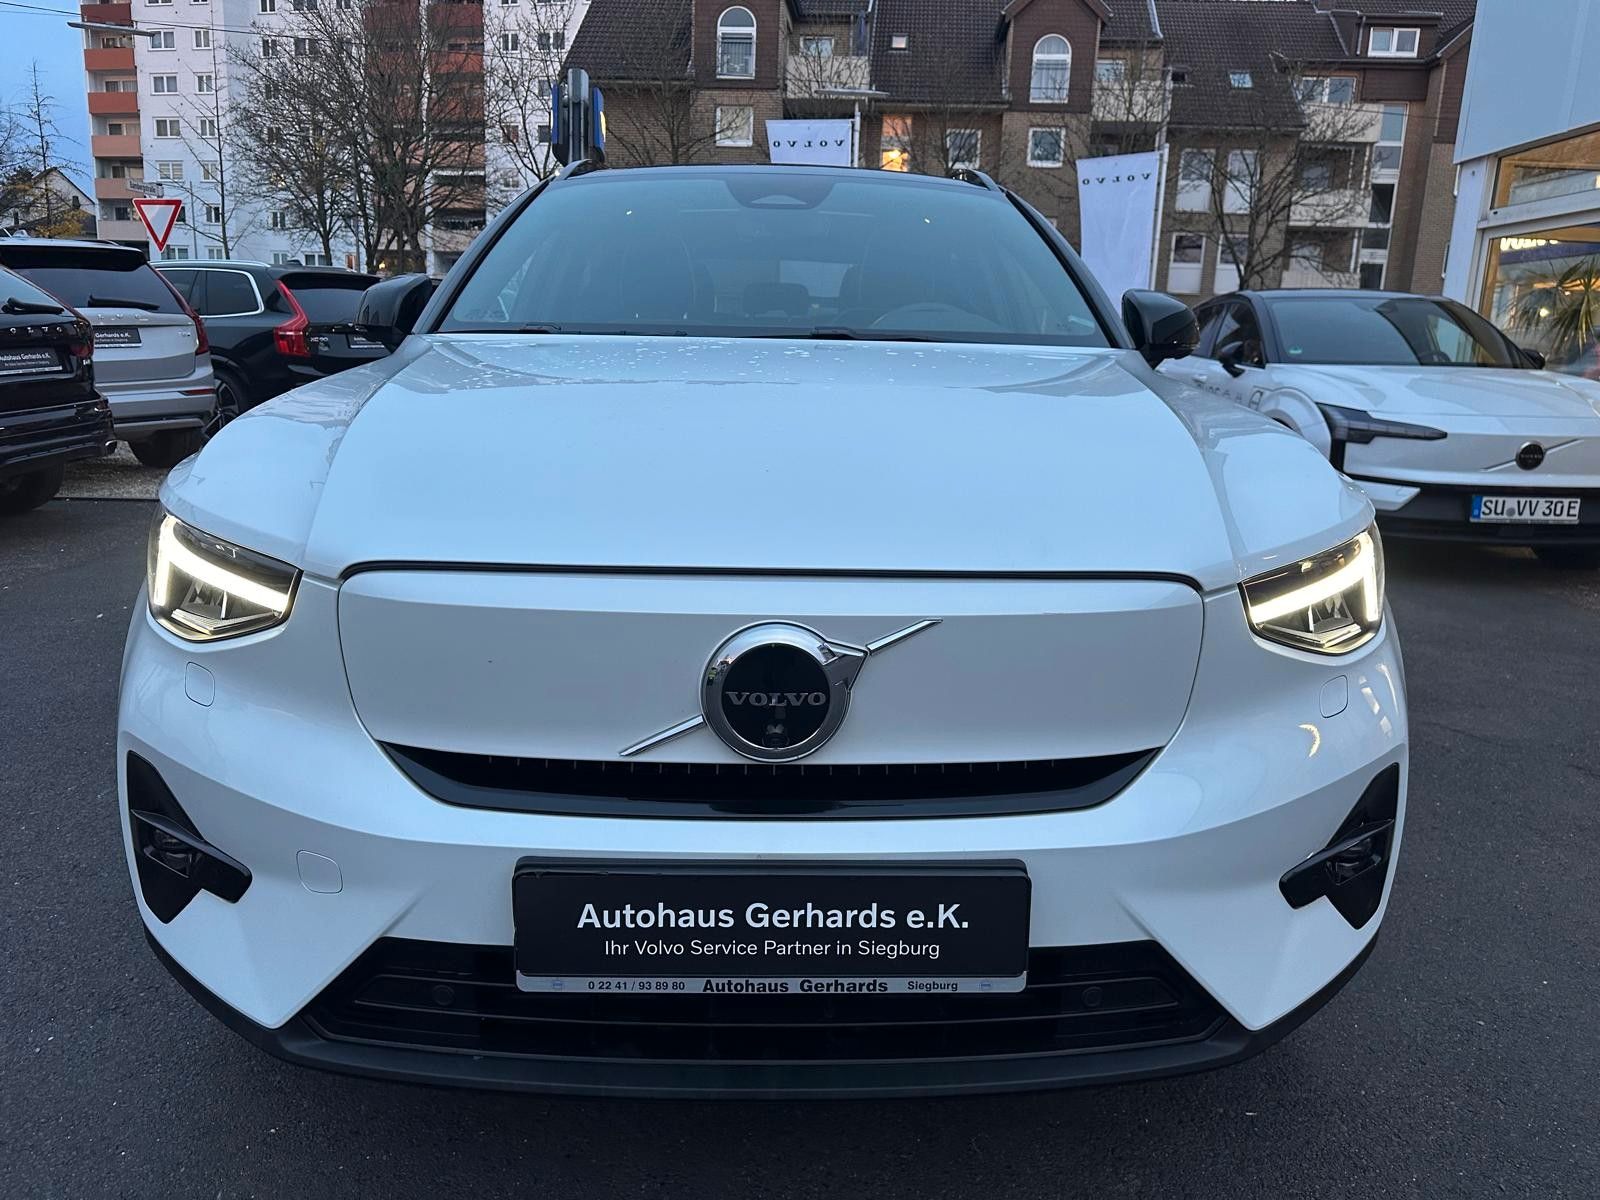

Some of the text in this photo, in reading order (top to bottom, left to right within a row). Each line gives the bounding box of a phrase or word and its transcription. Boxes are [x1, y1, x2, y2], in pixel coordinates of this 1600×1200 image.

[1482, 499, 1506, 516] SU
[1517, 500, 1540, 517] VV
[726, 691, 826, 707] VOLVO
[577, 902, 969, 929] Autohaus Gerhards e.K.
[605, 939, 940, 960] Ihr Volvo Service Partner in Siegburg
[588, 981, 595, 990] 0
[598, 981, 612, 990] 22
[615, 981, 627, 990] 41
[638, 981, 652, 991] 93
[655, 981, 669, 991] 89
[671, 981, 686, 991] 80
[703, 979, 789, 993] Autohaus
[800, 979, 888, 993] Gerhards
[907, 980, 958, 992] Siegburg
